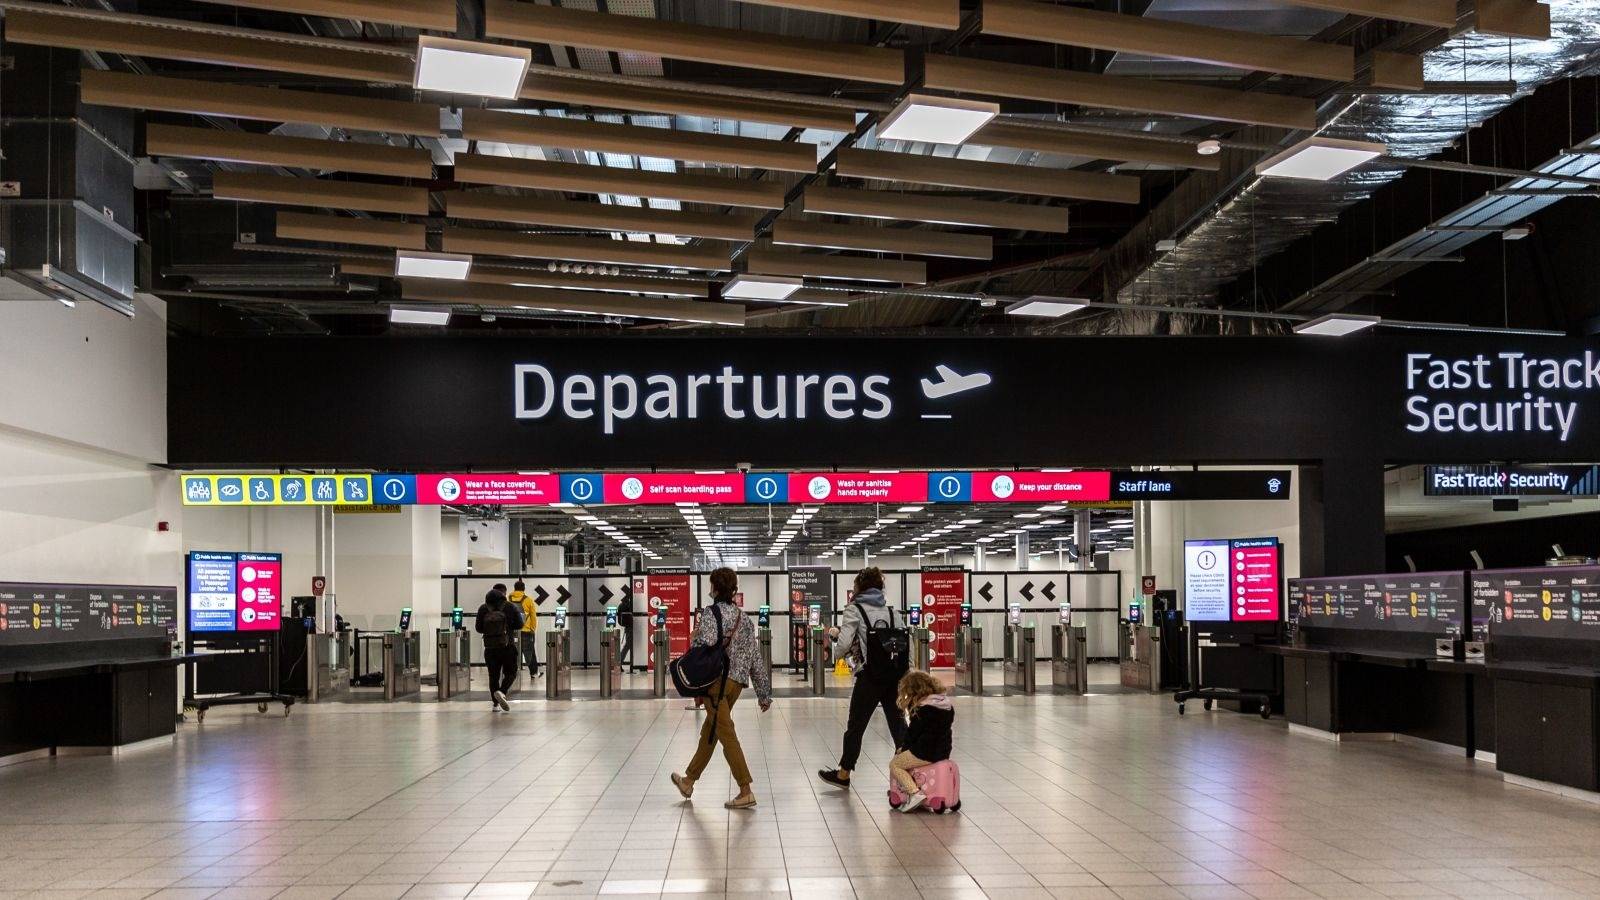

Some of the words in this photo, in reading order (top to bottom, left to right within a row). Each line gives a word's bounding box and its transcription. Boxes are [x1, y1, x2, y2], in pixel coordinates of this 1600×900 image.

[1406, 353, 1492, 390] Fast
[1498, 350, 1600, 389] Track
[514, 363, 893, 434] Departures
[1406, 392, 1577, 441] Security
[490, 480, 505, 488] face
[507, 481, 536, 489] covering
[1119, 481, 1147, 491] Staff
[1149, 481, 1171, 491] lane
[1434, 474, 1463, 488] Fast
[1465, 473, 1502, 488] Track
[1510, 473, 1568, 490] Security
[650, 485, 664, 493] Self
[683, 485, 714, 494] boarding
[715, 486, 732, 494] pass
[1053, 483, 1082, 491] distance
[859, 489, 888, 497] regularly
